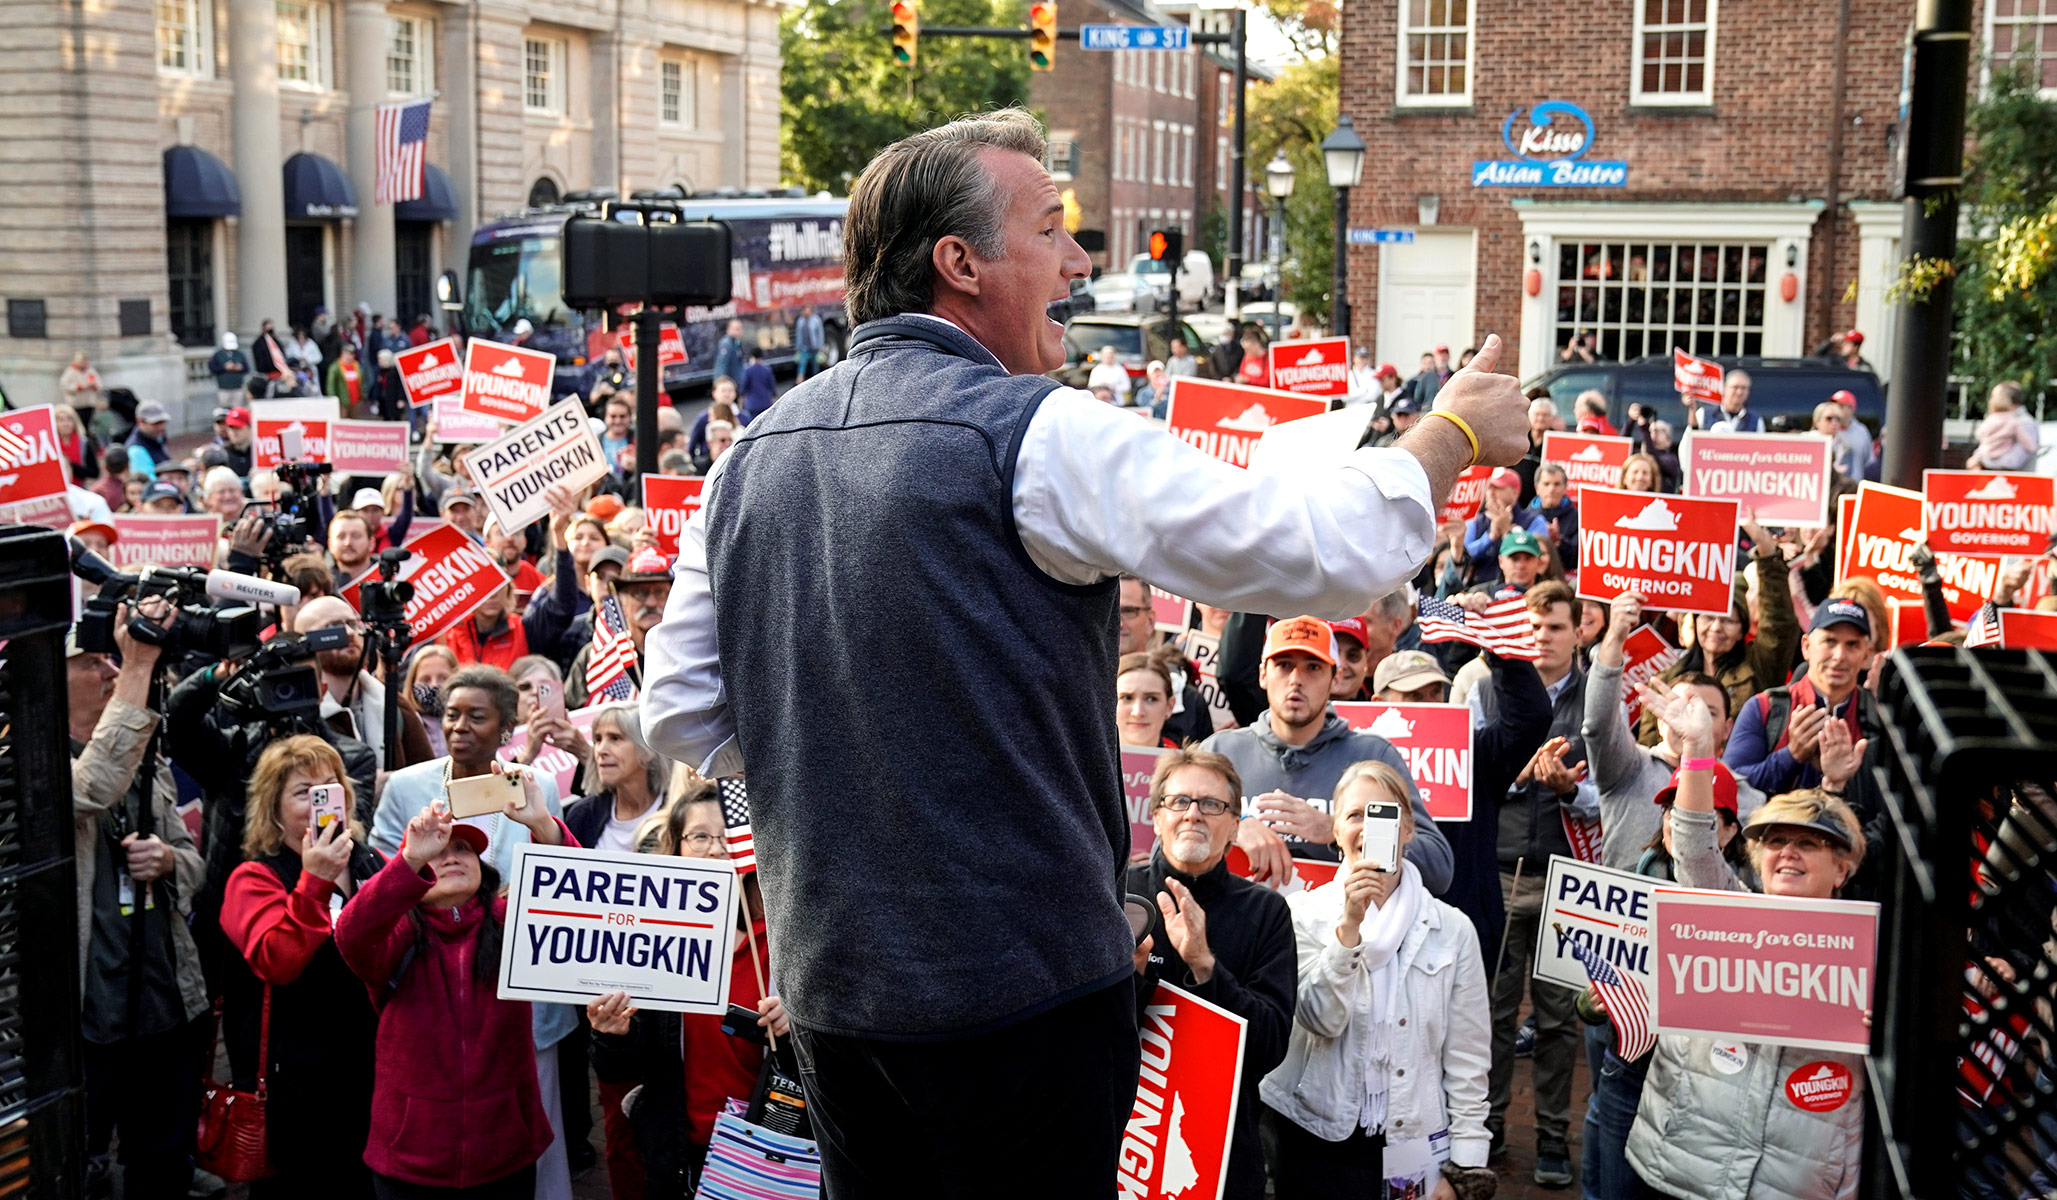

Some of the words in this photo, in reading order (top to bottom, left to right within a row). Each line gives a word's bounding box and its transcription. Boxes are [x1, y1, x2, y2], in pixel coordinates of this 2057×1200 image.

[1089, 27, 1130, 48] KING
[1162, 27, 1184, 48] ST
[1518, 125, 1584, 155] Kisso
[1473, 160, 1542, 187] Asian
[1548, 159, 1625, 185] Bistro
[405, 361, 463, 392] YOUNGKIN
[1275, 361, 1346, 388] YOUNGKIN
[468, 370, 549, 411] YOUNGKIN
[479, 395, 528, 414] GOVERNOR
[257, 436, 328, 458] YOUKIN
[333, 442, 404, 460] YOUNGKIN
[478, 410, 579, 478] PARENTS
[1698, 449, 1750, 463] Women
[1749, 452, 1773, 466] for
[1774, 453, 1812, 464] GLENN
[495, 440, 595, 512] YOUNGKIN
[1695, 468, 1819, 502] YOUNGKIN
[1926, 501, 2057, 535] YOUNGKIN
[117, 542, 213, 564] YOUNGKIN
[1950, 532, 2031, 547] GOVERNOR
[1580, 528, 1733, 585] YOUNGKIN
[1857, 532, 1997, 599] YOUKIN
[236, 585, 276, 599] REUTERS
[1602, 572, 1693, 596] GOVERNOR
[1877, 572, 1960, 604] GOVER
[531, 865, 720, 913] PARENTS
[1558, 873, 1648, 921] PARE
[607, 912, 635, 927] FOR
[1622, 923, 1648, 938] FOR
[1670, 923, 1755, 944] Women
[1753, 929, 1792, 950] for
[1792, 933, 1855, 950] GLENN
[527, 923, 713, 982] YOUNGKIN
[1667, 953, 1868, 1011] YOUNGKIN
[1712, 1046, 1744, 1068] YOUNGKIN
[1790, 1075, 1849, 1098] YOUNGKIN
[1803, 1090, 1843, 1103] GOVERNOR
